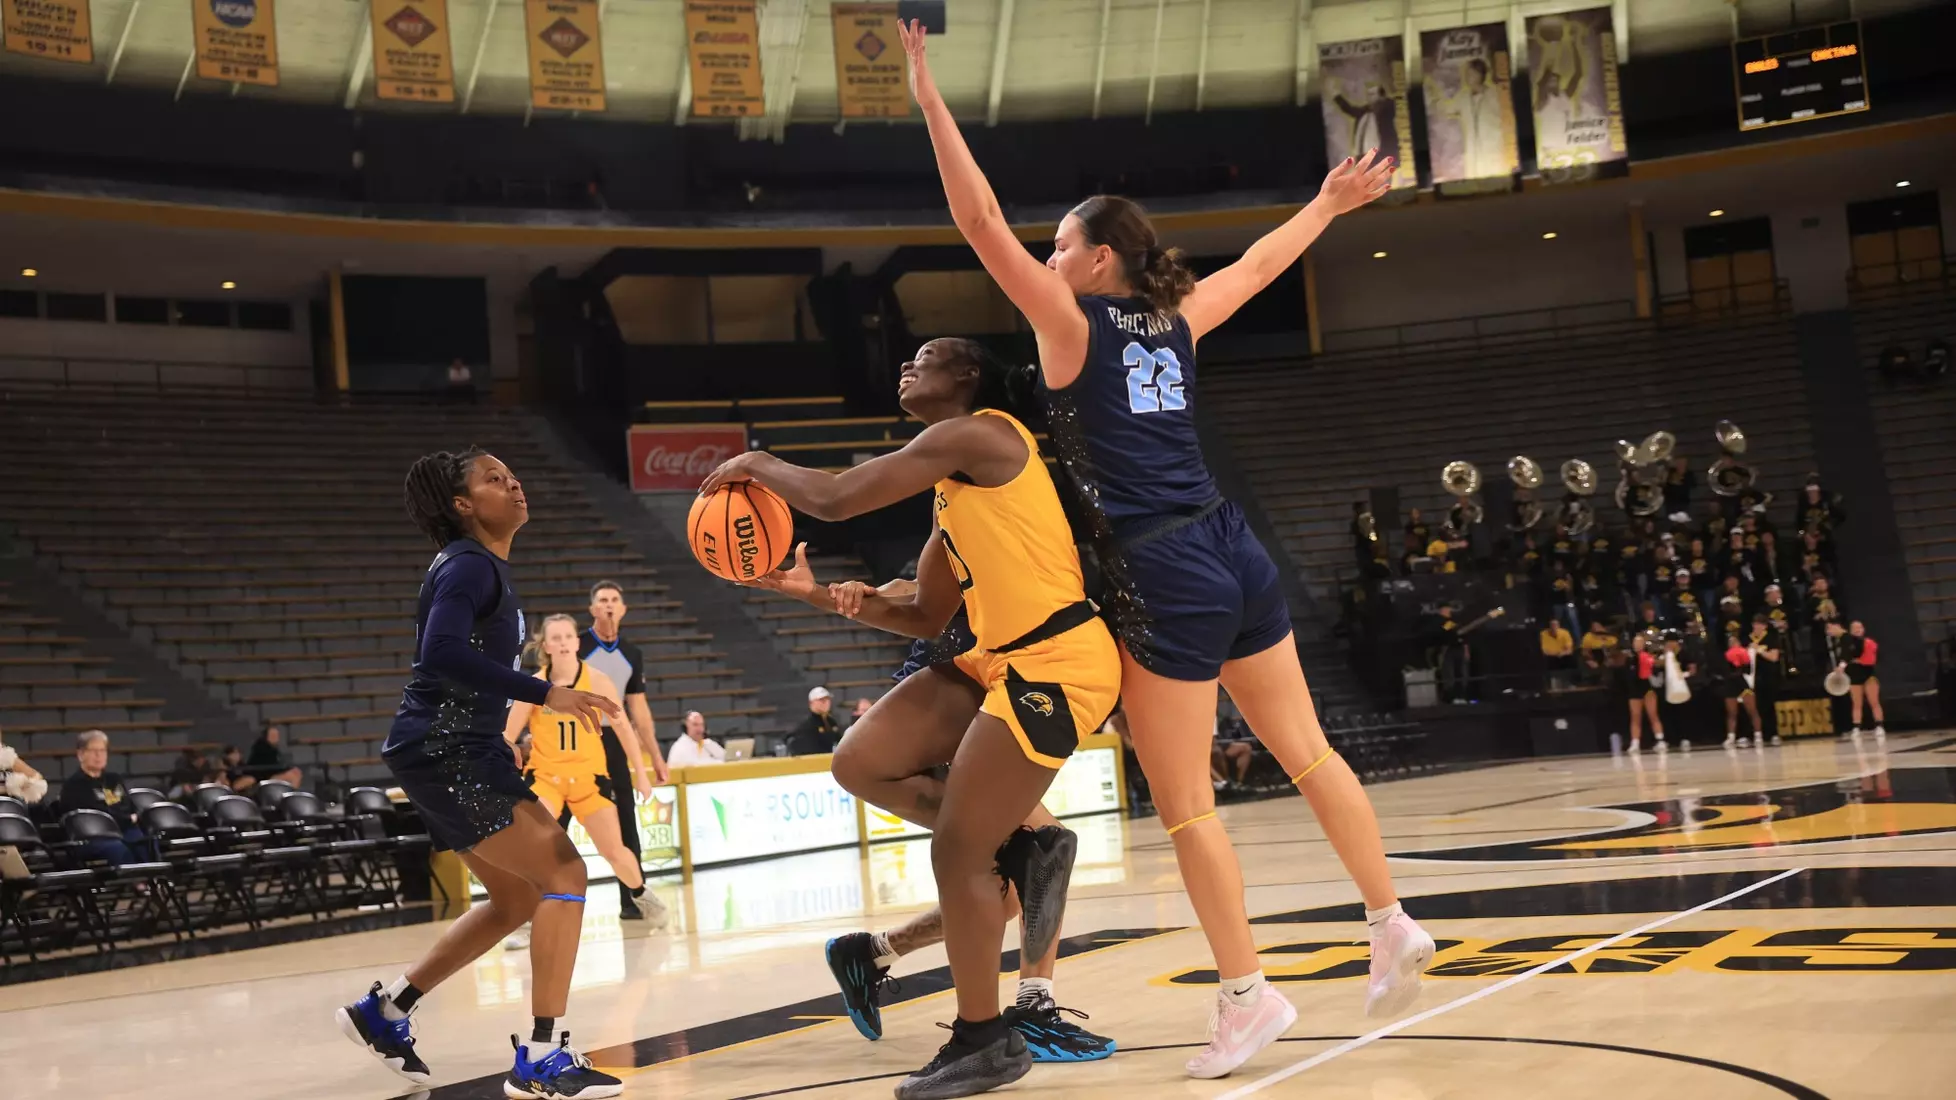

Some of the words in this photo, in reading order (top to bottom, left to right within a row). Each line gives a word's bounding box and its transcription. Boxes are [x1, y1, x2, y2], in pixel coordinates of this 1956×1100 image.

[215, 4, 256, 18] NCAA
[1122, 341, 1187, 414] 22
[733, 513, 759, 578] Wilson
[558, 721, 577, 751] 11
[742, 788, 853, 823] ARSOUTH
